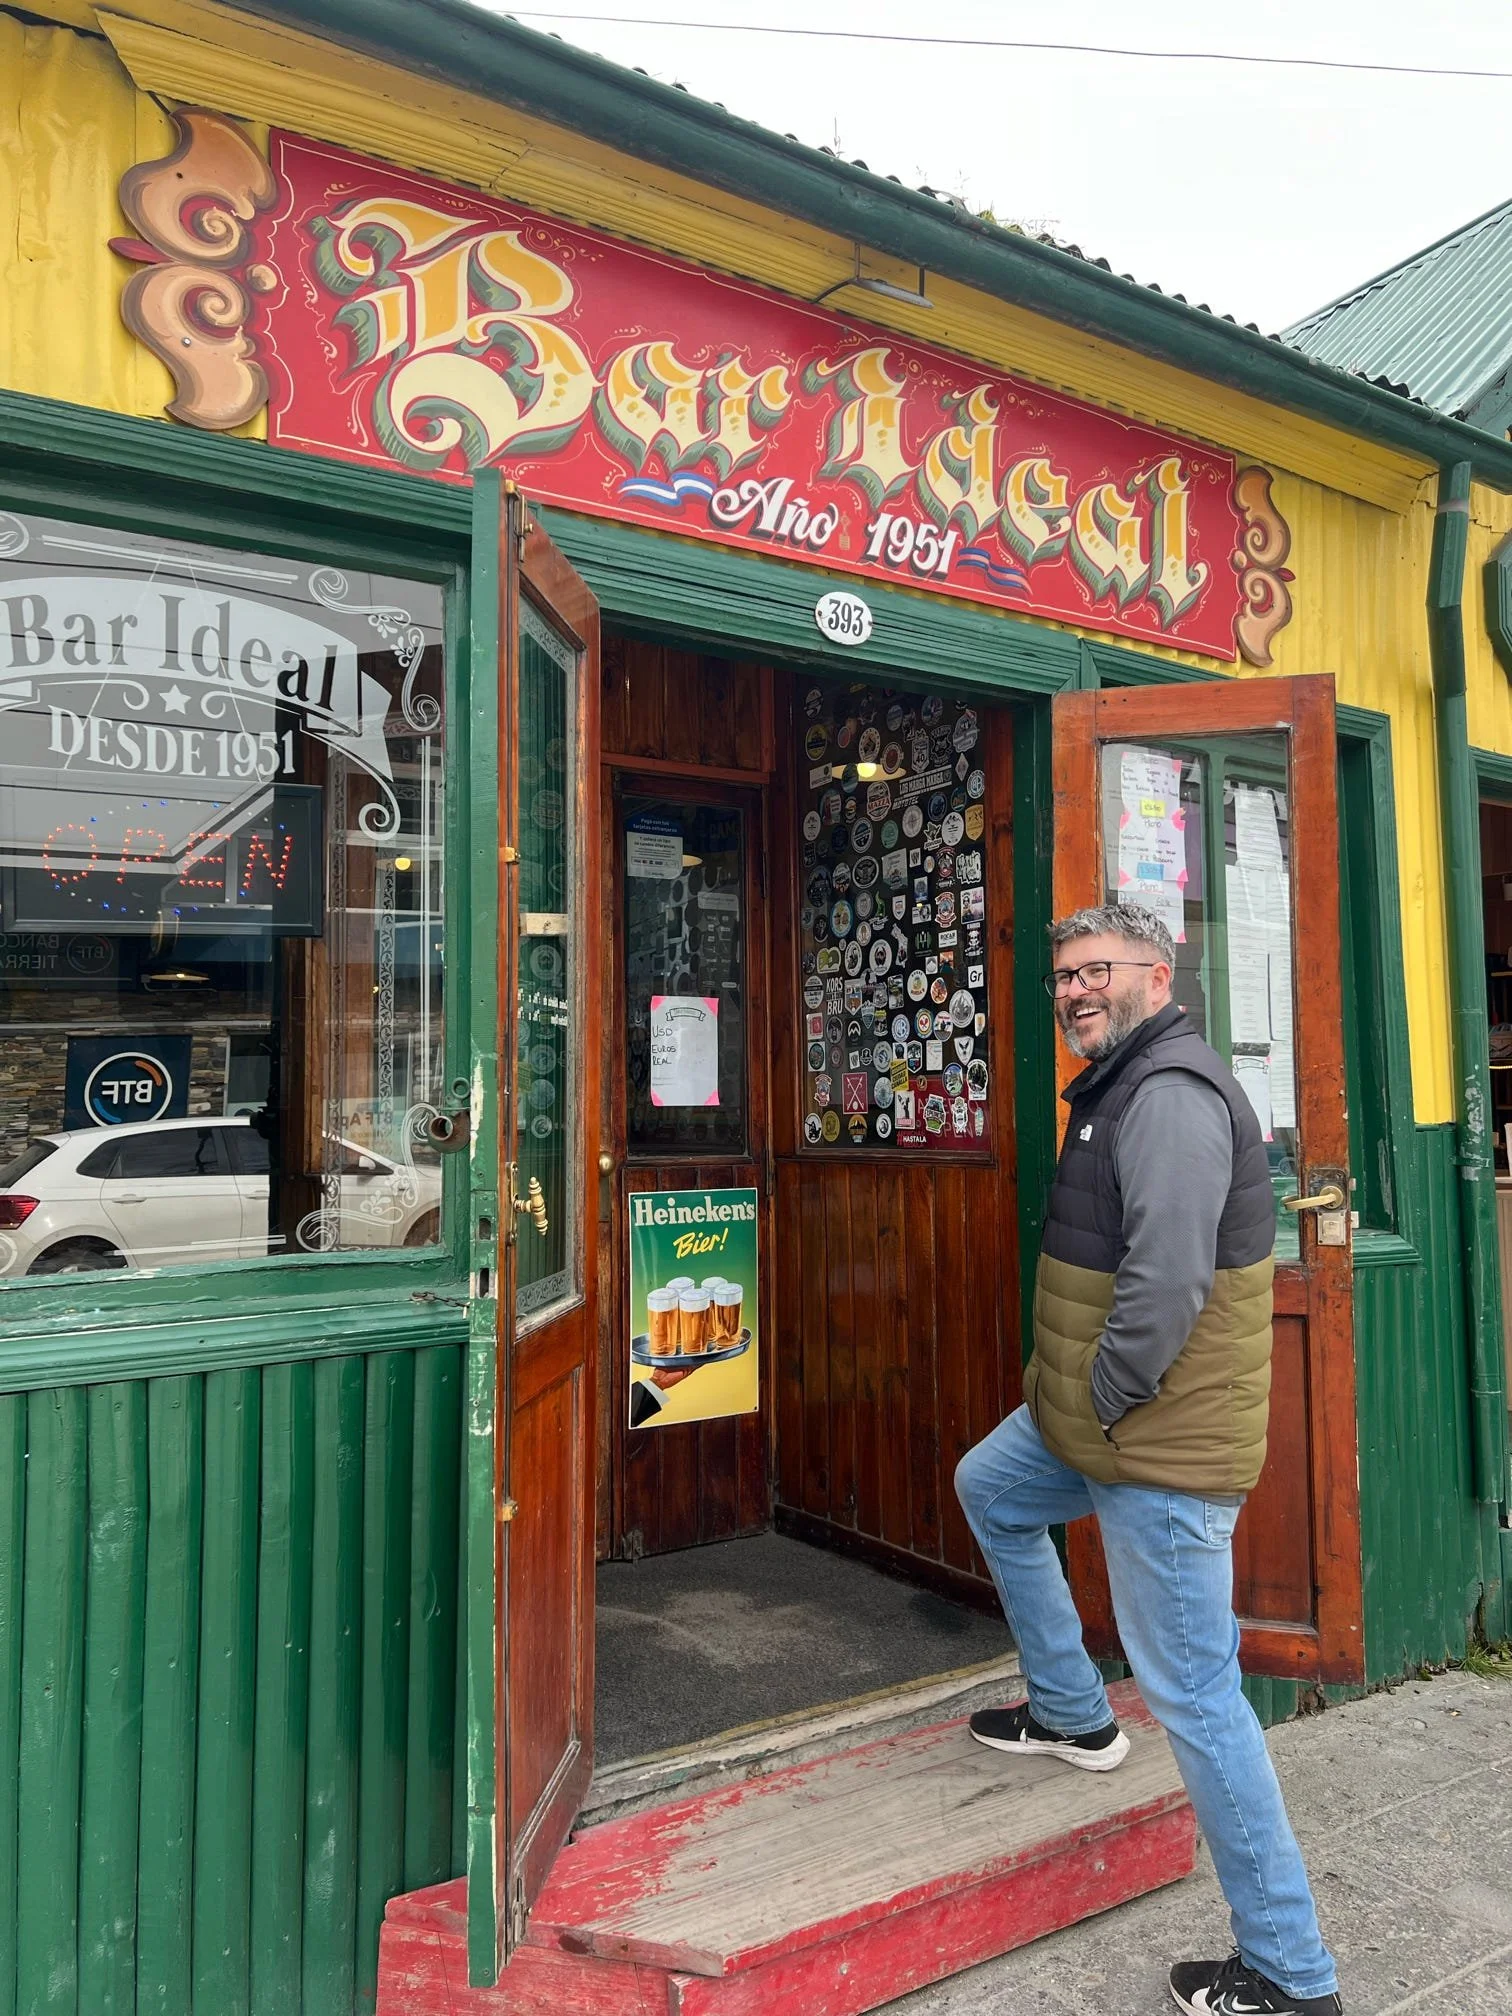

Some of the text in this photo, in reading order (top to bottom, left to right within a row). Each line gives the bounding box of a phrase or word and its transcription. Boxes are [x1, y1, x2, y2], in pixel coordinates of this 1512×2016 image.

[312, 197, 1208, 624] Bar Ideal
[709, 477, 958, 578] Año 1951
[827, 598, 864, 637] 393
[2, 592, 340, 712] Bar Ideal
[48, 704, 297, 778] DESDE 1951
[43, 824, 293, 890] OPEN
[651, 1044, 677, 1054] EUROS
[652, 1025, 674, 1038] USD
[634, 1195, 755, 1227] Heineken's
[672, 1227, 729, 1259] Bier!
